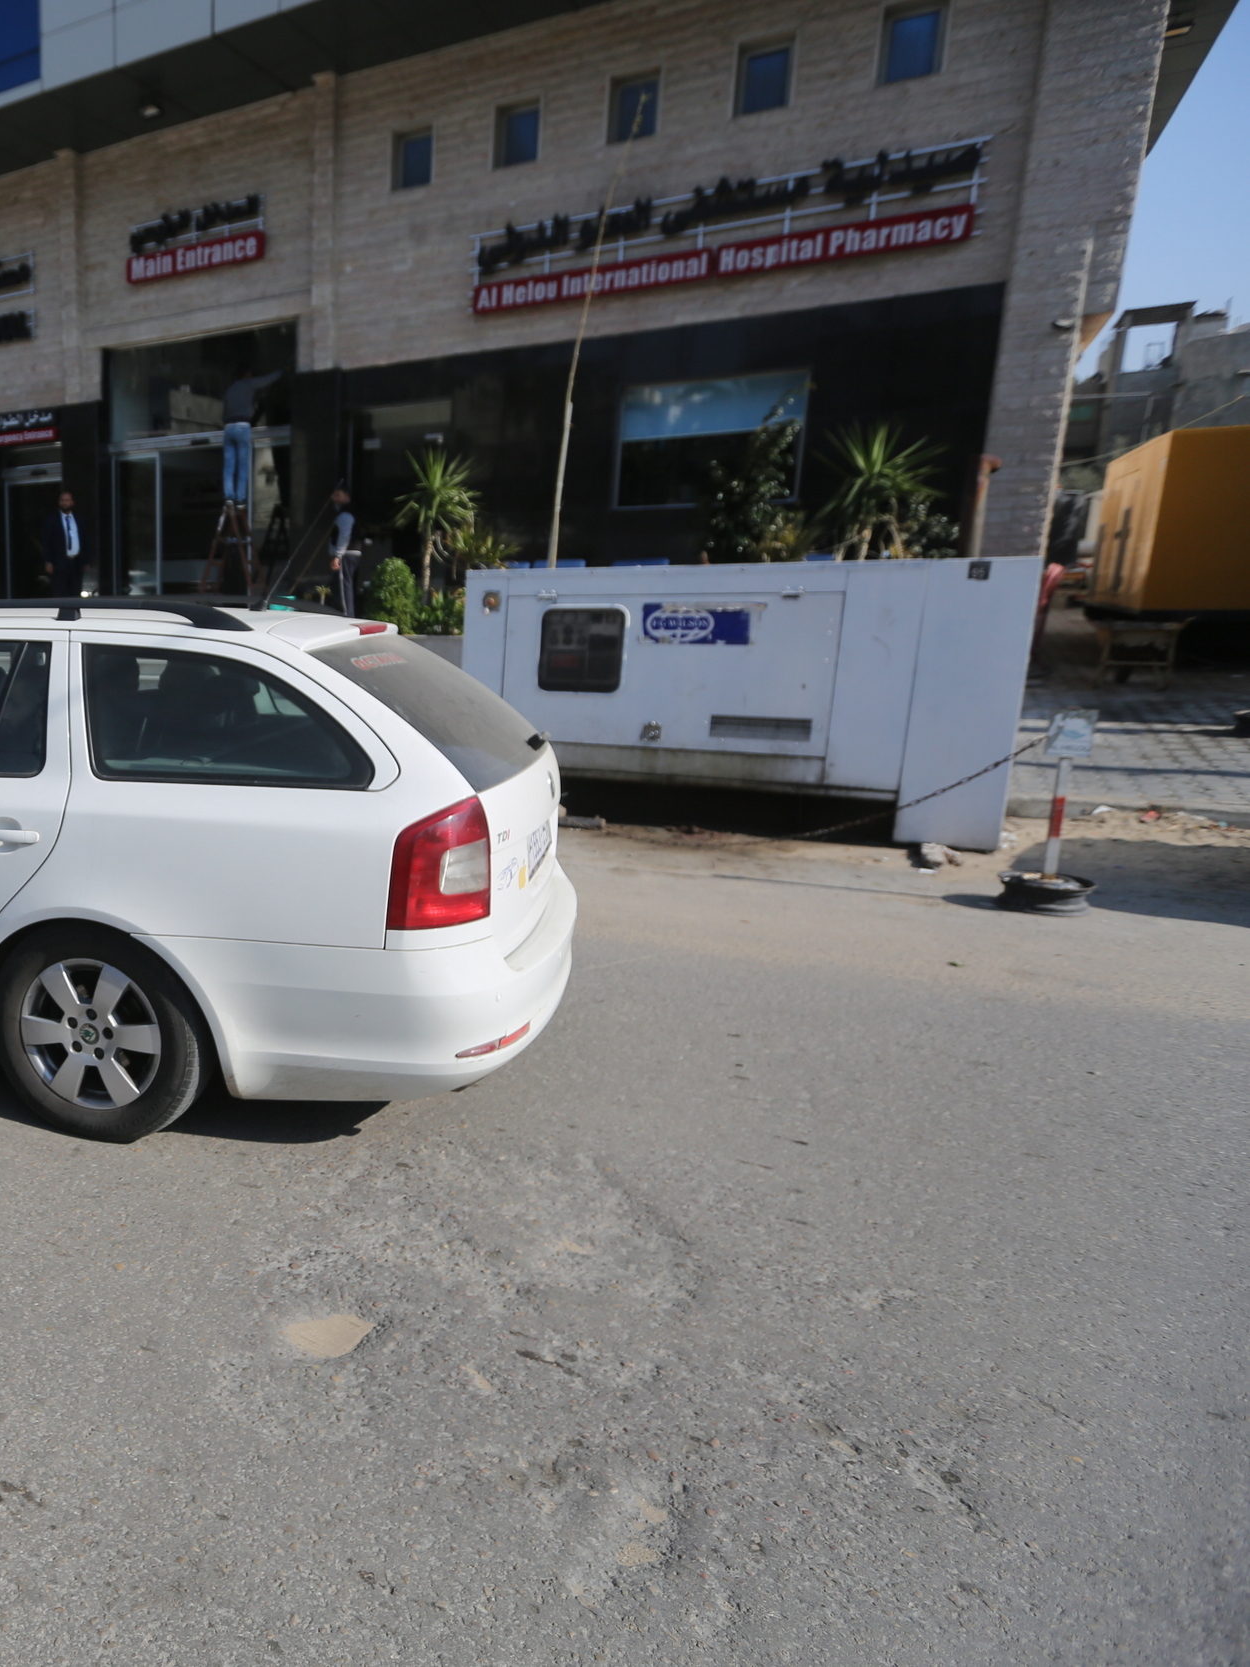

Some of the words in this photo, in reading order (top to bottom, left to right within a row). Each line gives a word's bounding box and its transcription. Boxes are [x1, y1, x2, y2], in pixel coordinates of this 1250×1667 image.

[660, 173, 810, 236] مستشفى
[130, 253, 174, 281] Main
[176, 236, 257, 271] Entrance
[476, 285, 498, 309] Al
[501, 280, 558, 305] Helou
[562, 252, 709, 298] International
[718, 234, 823, 273] Hospital
[828, 212, 970, 255] Pharmacy
[23, 429, 54, 440] Entrance
[497, 828, 511, 844] TDI
